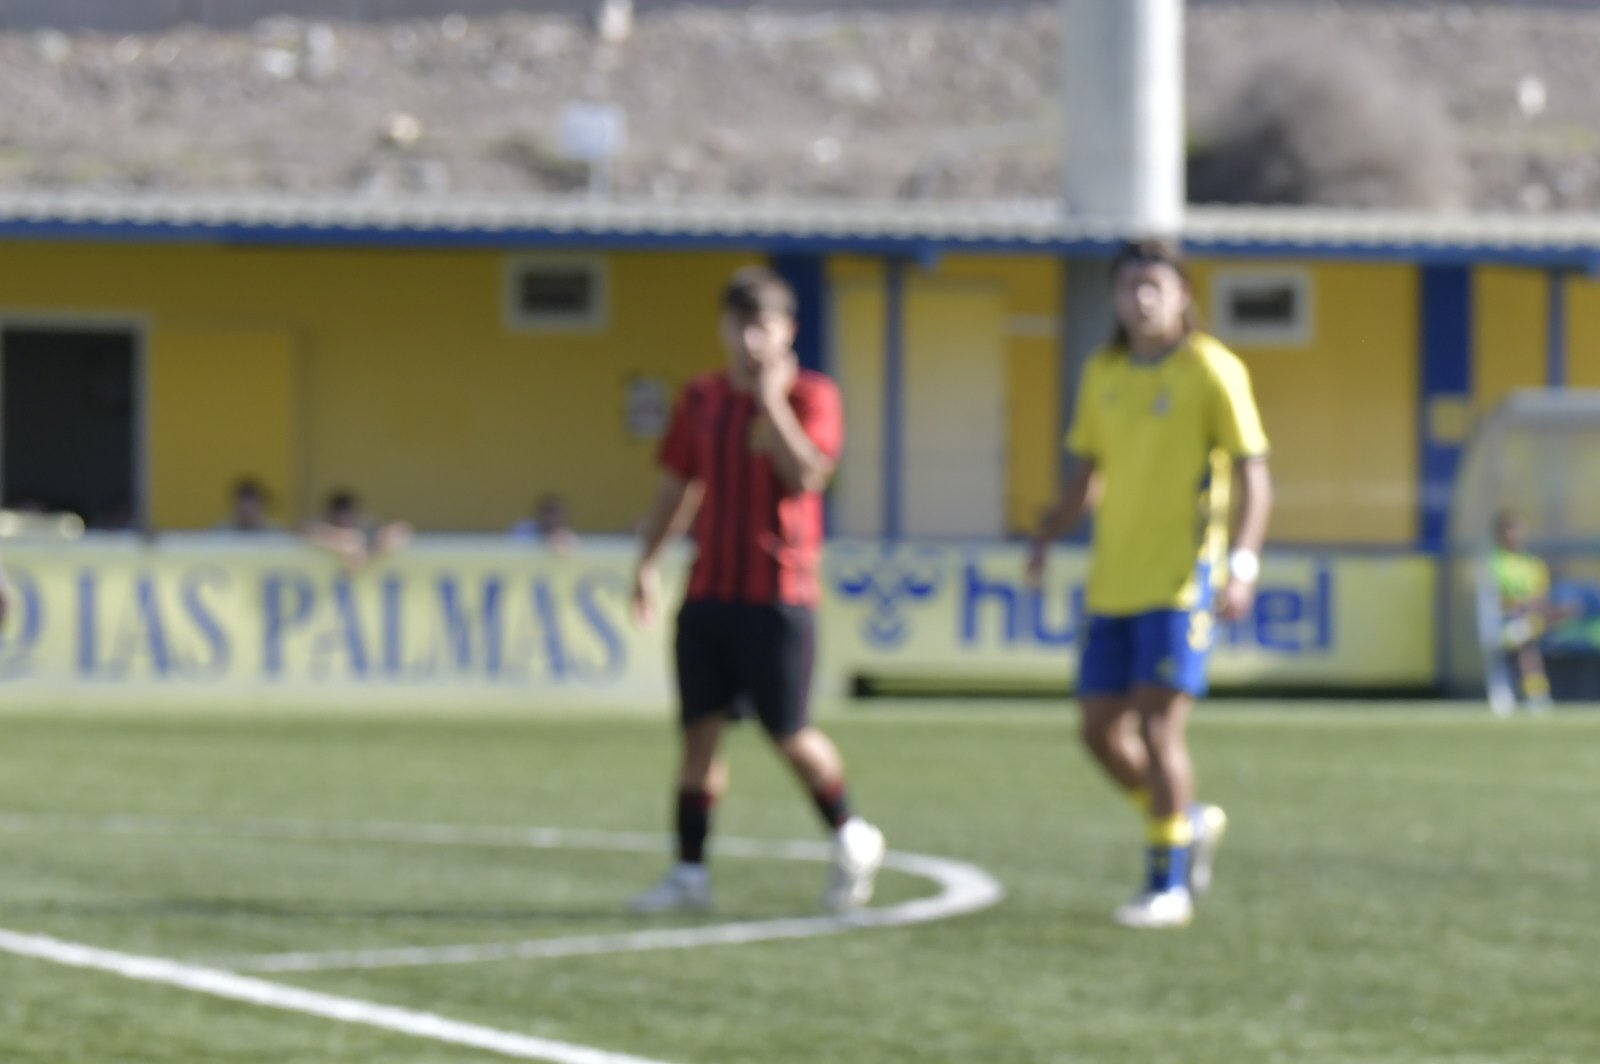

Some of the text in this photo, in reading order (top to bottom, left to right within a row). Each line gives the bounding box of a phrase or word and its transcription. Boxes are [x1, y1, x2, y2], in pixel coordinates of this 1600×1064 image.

[74, 566, 231, 684] LAS
[260, 566, 628, 684] PALMAS
[959, 562, 1333, 652] huel
